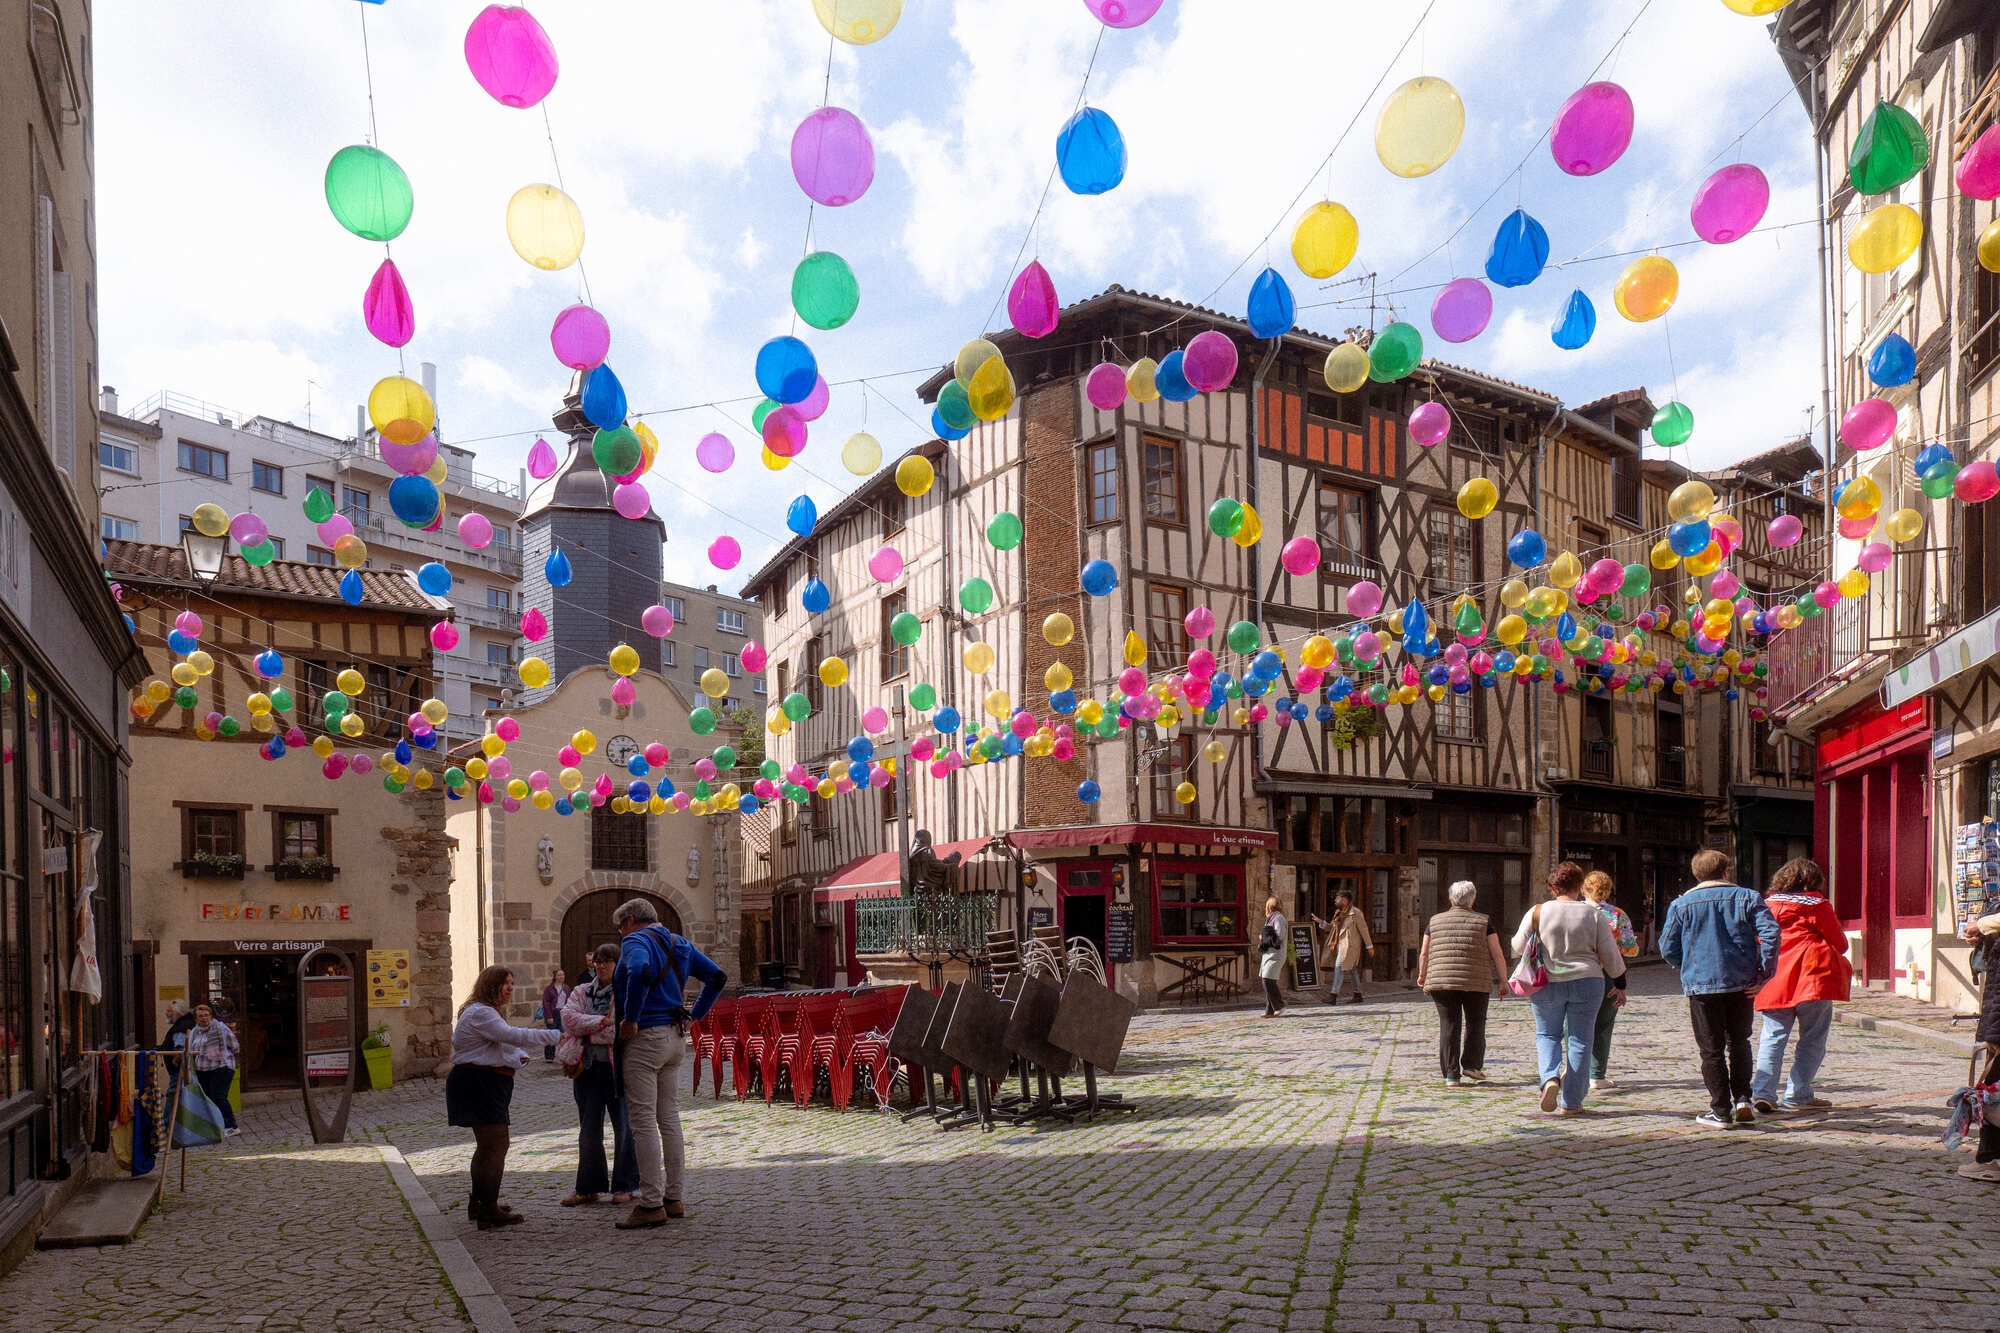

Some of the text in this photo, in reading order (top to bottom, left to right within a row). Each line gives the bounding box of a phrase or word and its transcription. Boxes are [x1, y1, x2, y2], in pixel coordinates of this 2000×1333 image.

[1222, 834, 1236, 843] duc
[202, 904, 351, 921] FEU ET FLAMME
[234, 940, 325, 951] Verre artisanal
